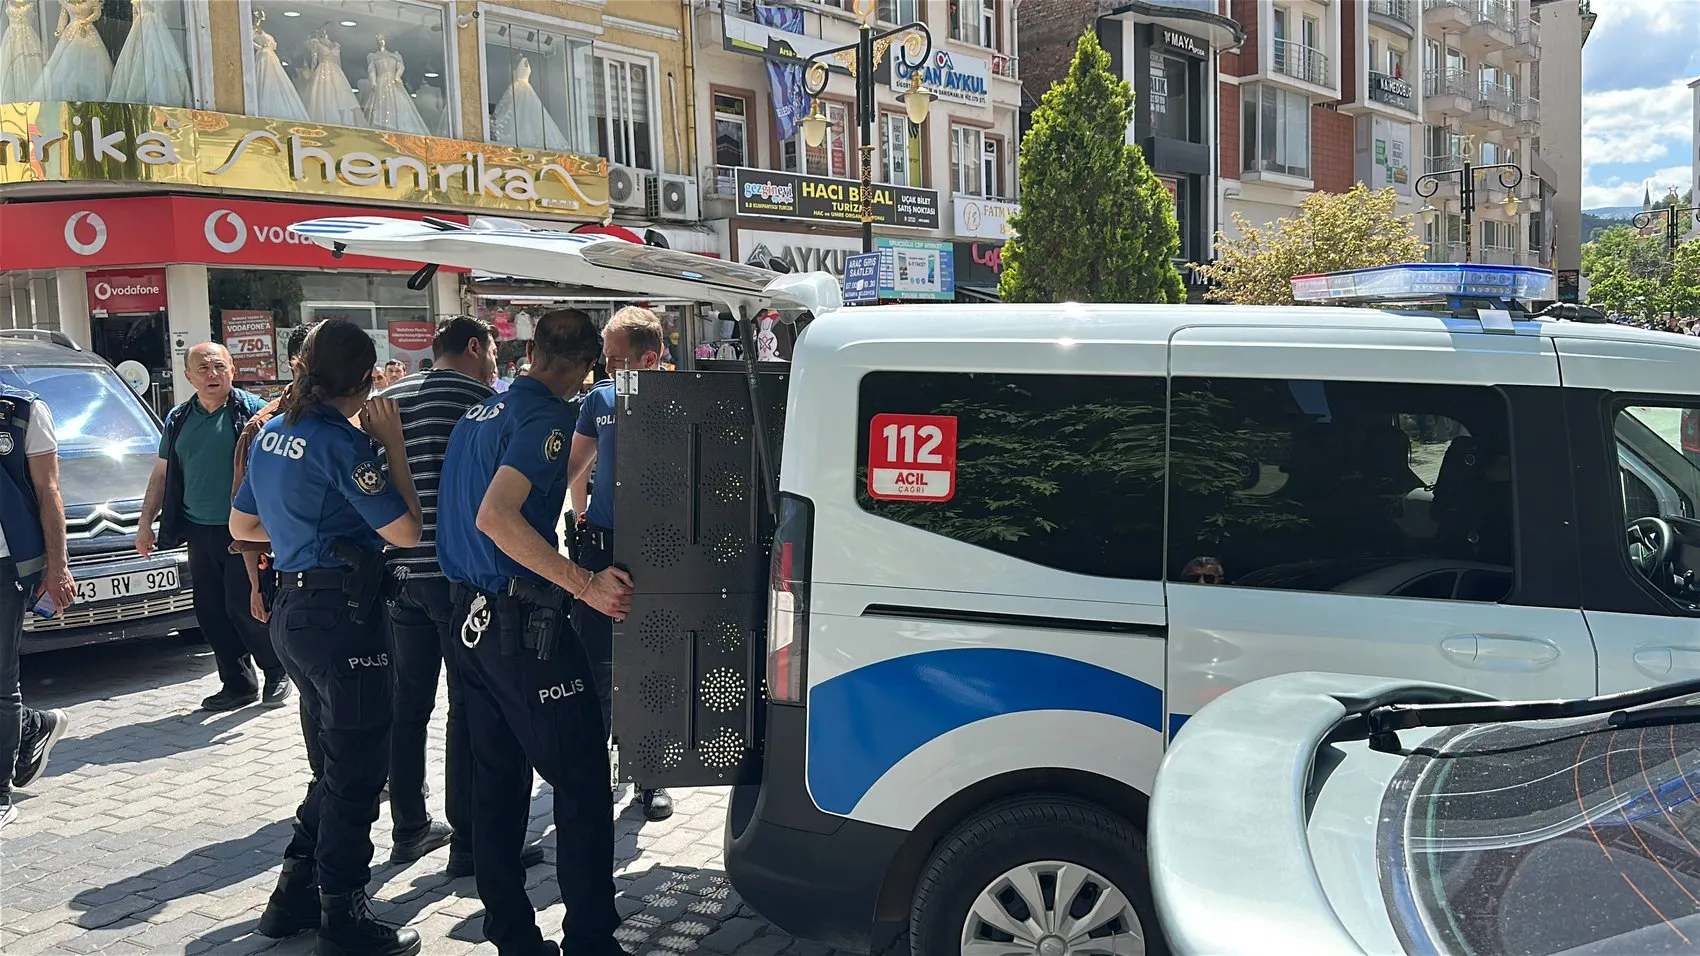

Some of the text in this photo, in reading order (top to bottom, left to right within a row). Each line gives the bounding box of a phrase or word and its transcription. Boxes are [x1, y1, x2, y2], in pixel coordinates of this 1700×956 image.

[1171, 32, 1194, 51] MAYA
[894, 56, 942, 86] ÖAN
[945, 71, 987, 95] AYKUL
[290, 135, 539, 200] henrika
[802, 182, 893, 205] HACI BAL
[901, 195, 931, 205] UÇAK BİLET
[832, 201, 863, 213] TURİZ
[897, 204, 935, 215] SATIŞ NOKTASI
[111, 285, 159, 295] vodafone
[227, 322, 271, 332] VODAFONE'A
[238, 338, 264, 352] 750
[883, 424, 943, 464] 112
[895, 471, 928, 485] ACİL
[77, 571, 176, 600] 43 RV 920
